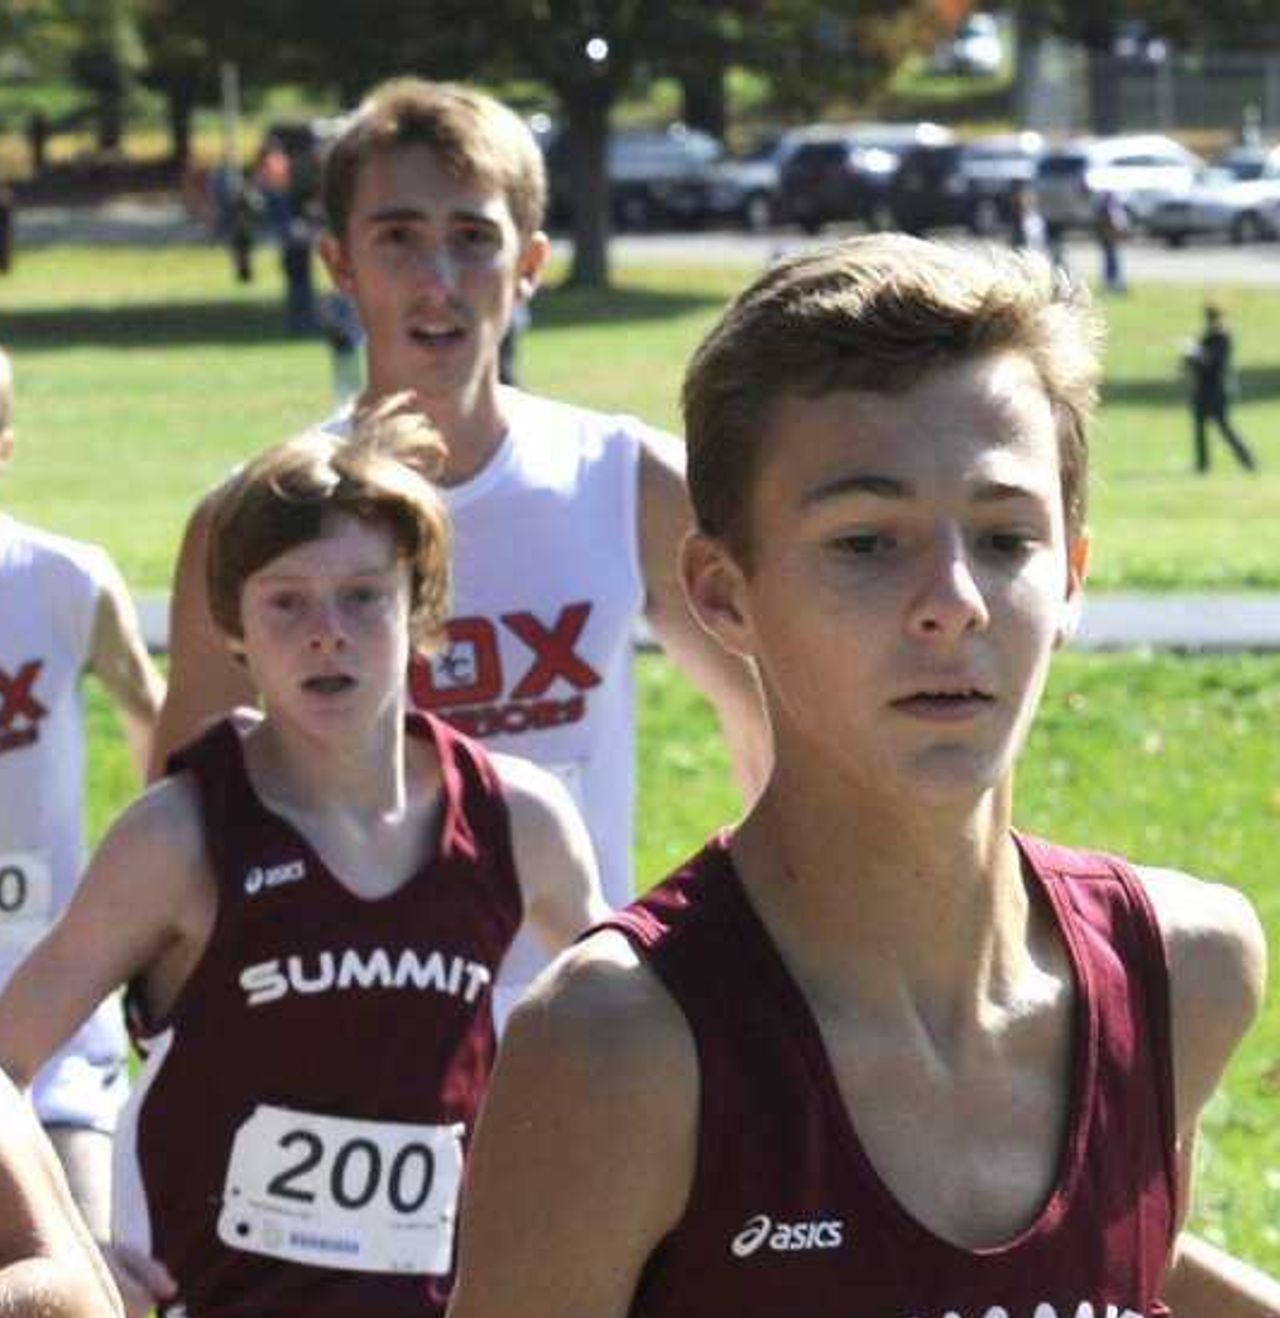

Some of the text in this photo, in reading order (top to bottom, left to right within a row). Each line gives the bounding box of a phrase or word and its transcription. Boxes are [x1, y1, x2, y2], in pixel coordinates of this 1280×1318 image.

[408, 601, 603, 709] OX
[239, 947, 492, 1007] SUMMIT
[266, 1129, 435, 1214] 200
